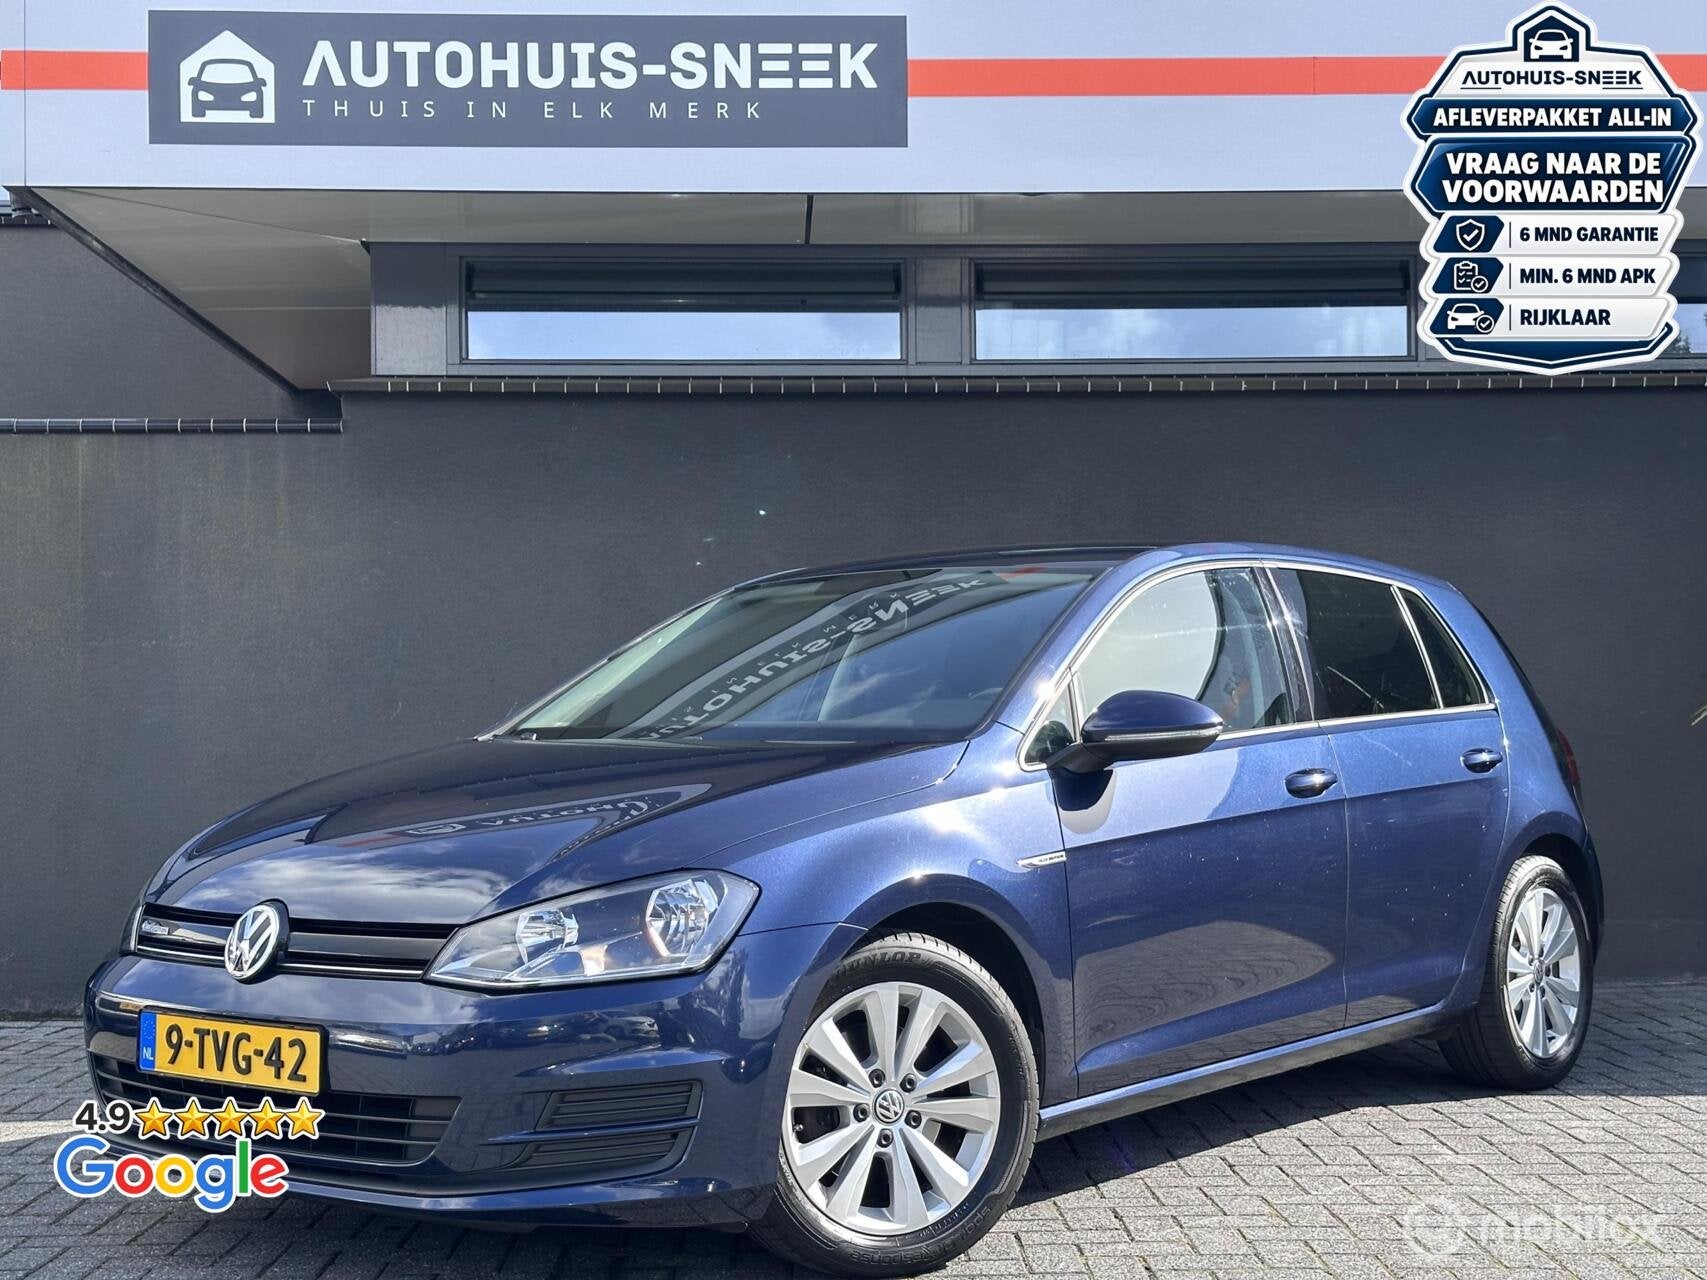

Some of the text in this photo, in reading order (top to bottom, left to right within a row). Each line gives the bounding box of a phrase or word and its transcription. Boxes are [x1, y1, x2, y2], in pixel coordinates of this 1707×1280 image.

[302, 40, 878, 89] AUTOHUIS-SNEEK
[302, 100, 761, 119] THUIS IN ELK MERK
[142, 1047, 154, 1060] NL
[165, 1023, 307, 1083] 9-TVG-42
